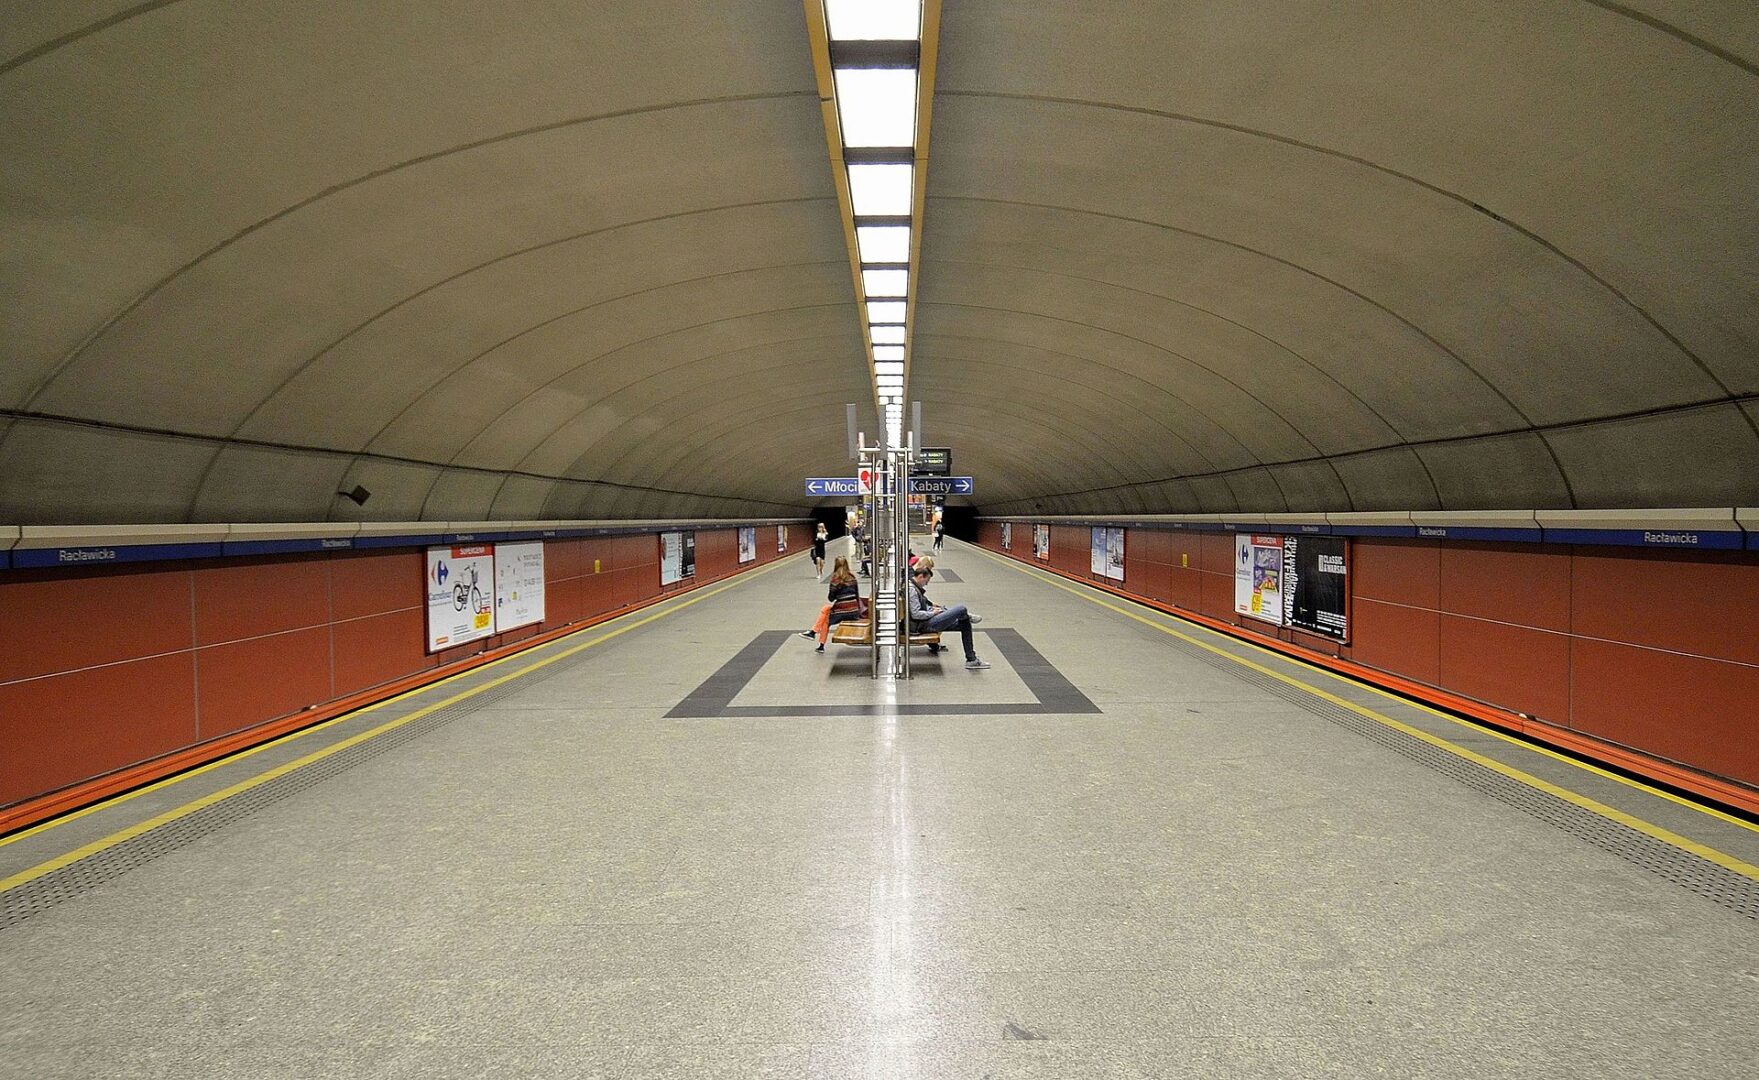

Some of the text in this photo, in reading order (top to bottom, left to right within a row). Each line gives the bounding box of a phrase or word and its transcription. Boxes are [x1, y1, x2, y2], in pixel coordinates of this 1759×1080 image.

[824, 480, 858, 492] Młoci
[910, 480, 952, 493] Kabaty
[1644, 531, 1698, 544] Racławicka
[59, 547, 117, 561] Racławicka
